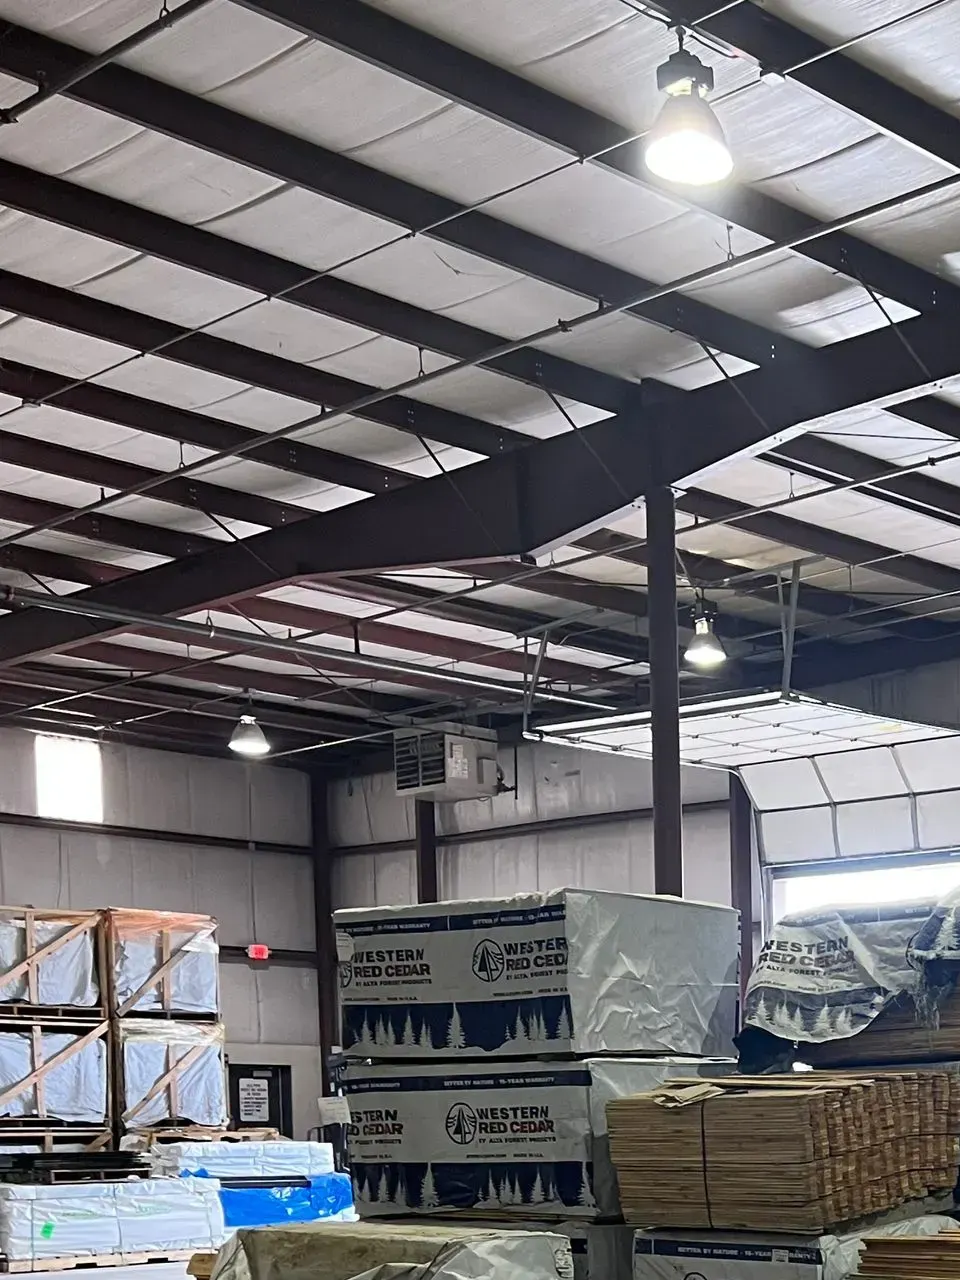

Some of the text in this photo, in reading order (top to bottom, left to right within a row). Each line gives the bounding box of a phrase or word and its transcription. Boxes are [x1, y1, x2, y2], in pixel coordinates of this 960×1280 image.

[503, 937, 568, 955] WESTER
[760, 936, 848, 955] WESTERN
[353, 949, 424, 963] WESTERN
[506, 953, 568, 971] RED CED
[758, 952, 797, 965] RED
[353, 963, 431, 978] RED CEDAR
[789, 968, 821, 976] FOREST
[350, 1110, 397, 1123] ESTERN
[476, 1106, 548, 1120] WESTERN
[363, 1123, 404, 1136] CEDAR
[479, 1119, 554, 1134] RED CEDAR
